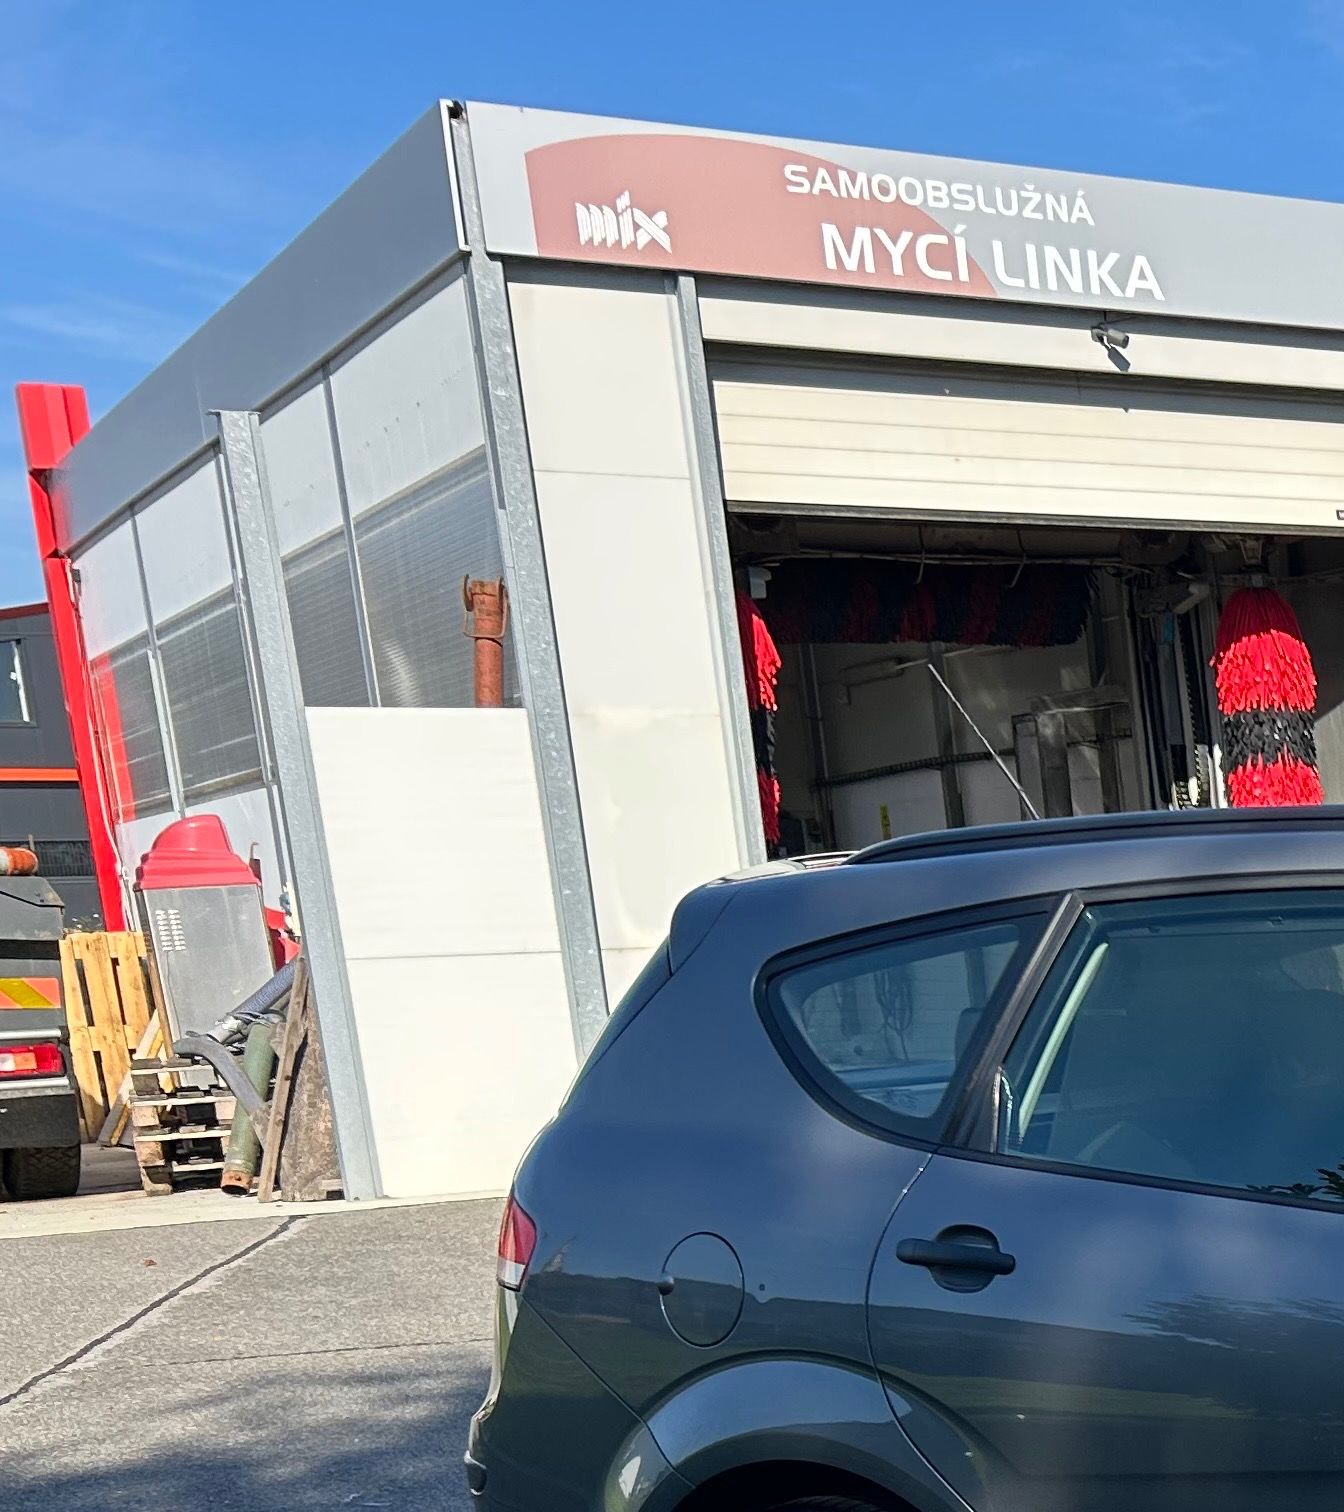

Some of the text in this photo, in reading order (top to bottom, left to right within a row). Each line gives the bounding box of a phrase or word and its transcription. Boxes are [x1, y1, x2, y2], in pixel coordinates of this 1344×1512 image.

[784, 164, 1096, 226] SAMOOBSLUŽNÁ
[821, 224, 1166, 301] MYCÍ LINKA
